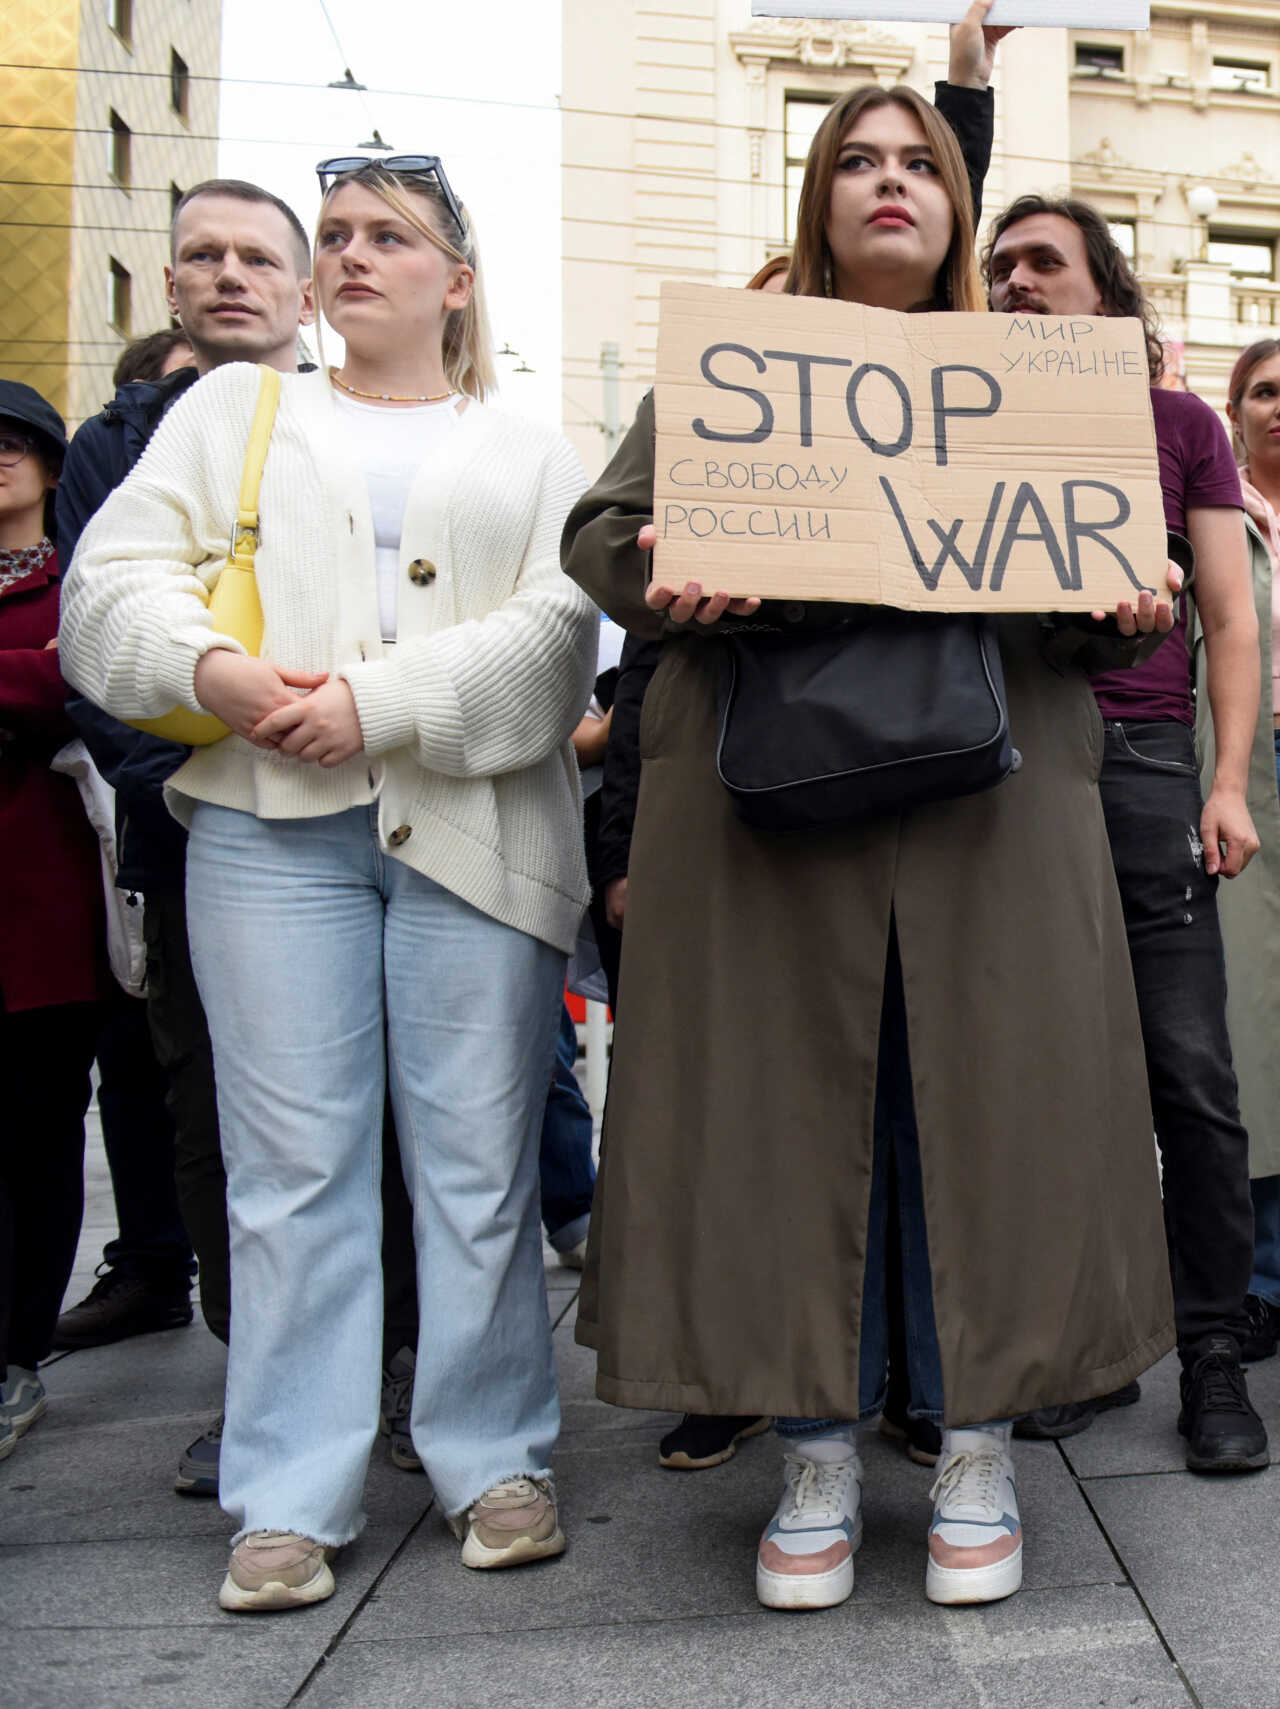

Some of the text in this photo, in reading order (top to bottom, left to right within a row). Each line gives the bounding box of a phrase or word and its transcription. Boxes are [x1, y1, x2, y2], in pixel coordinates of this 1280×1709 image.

[1005, 318, 1094, 343] МИР
[1000, 349, 1143, 376] УКРАИНЕ
[691, 342, 1002, 466] STOP
[669, 458, 848, 493] СВОБОДУ
[663, 504, 831, 540] РОССИИ
[878, 475, 1158, 595] WAR
